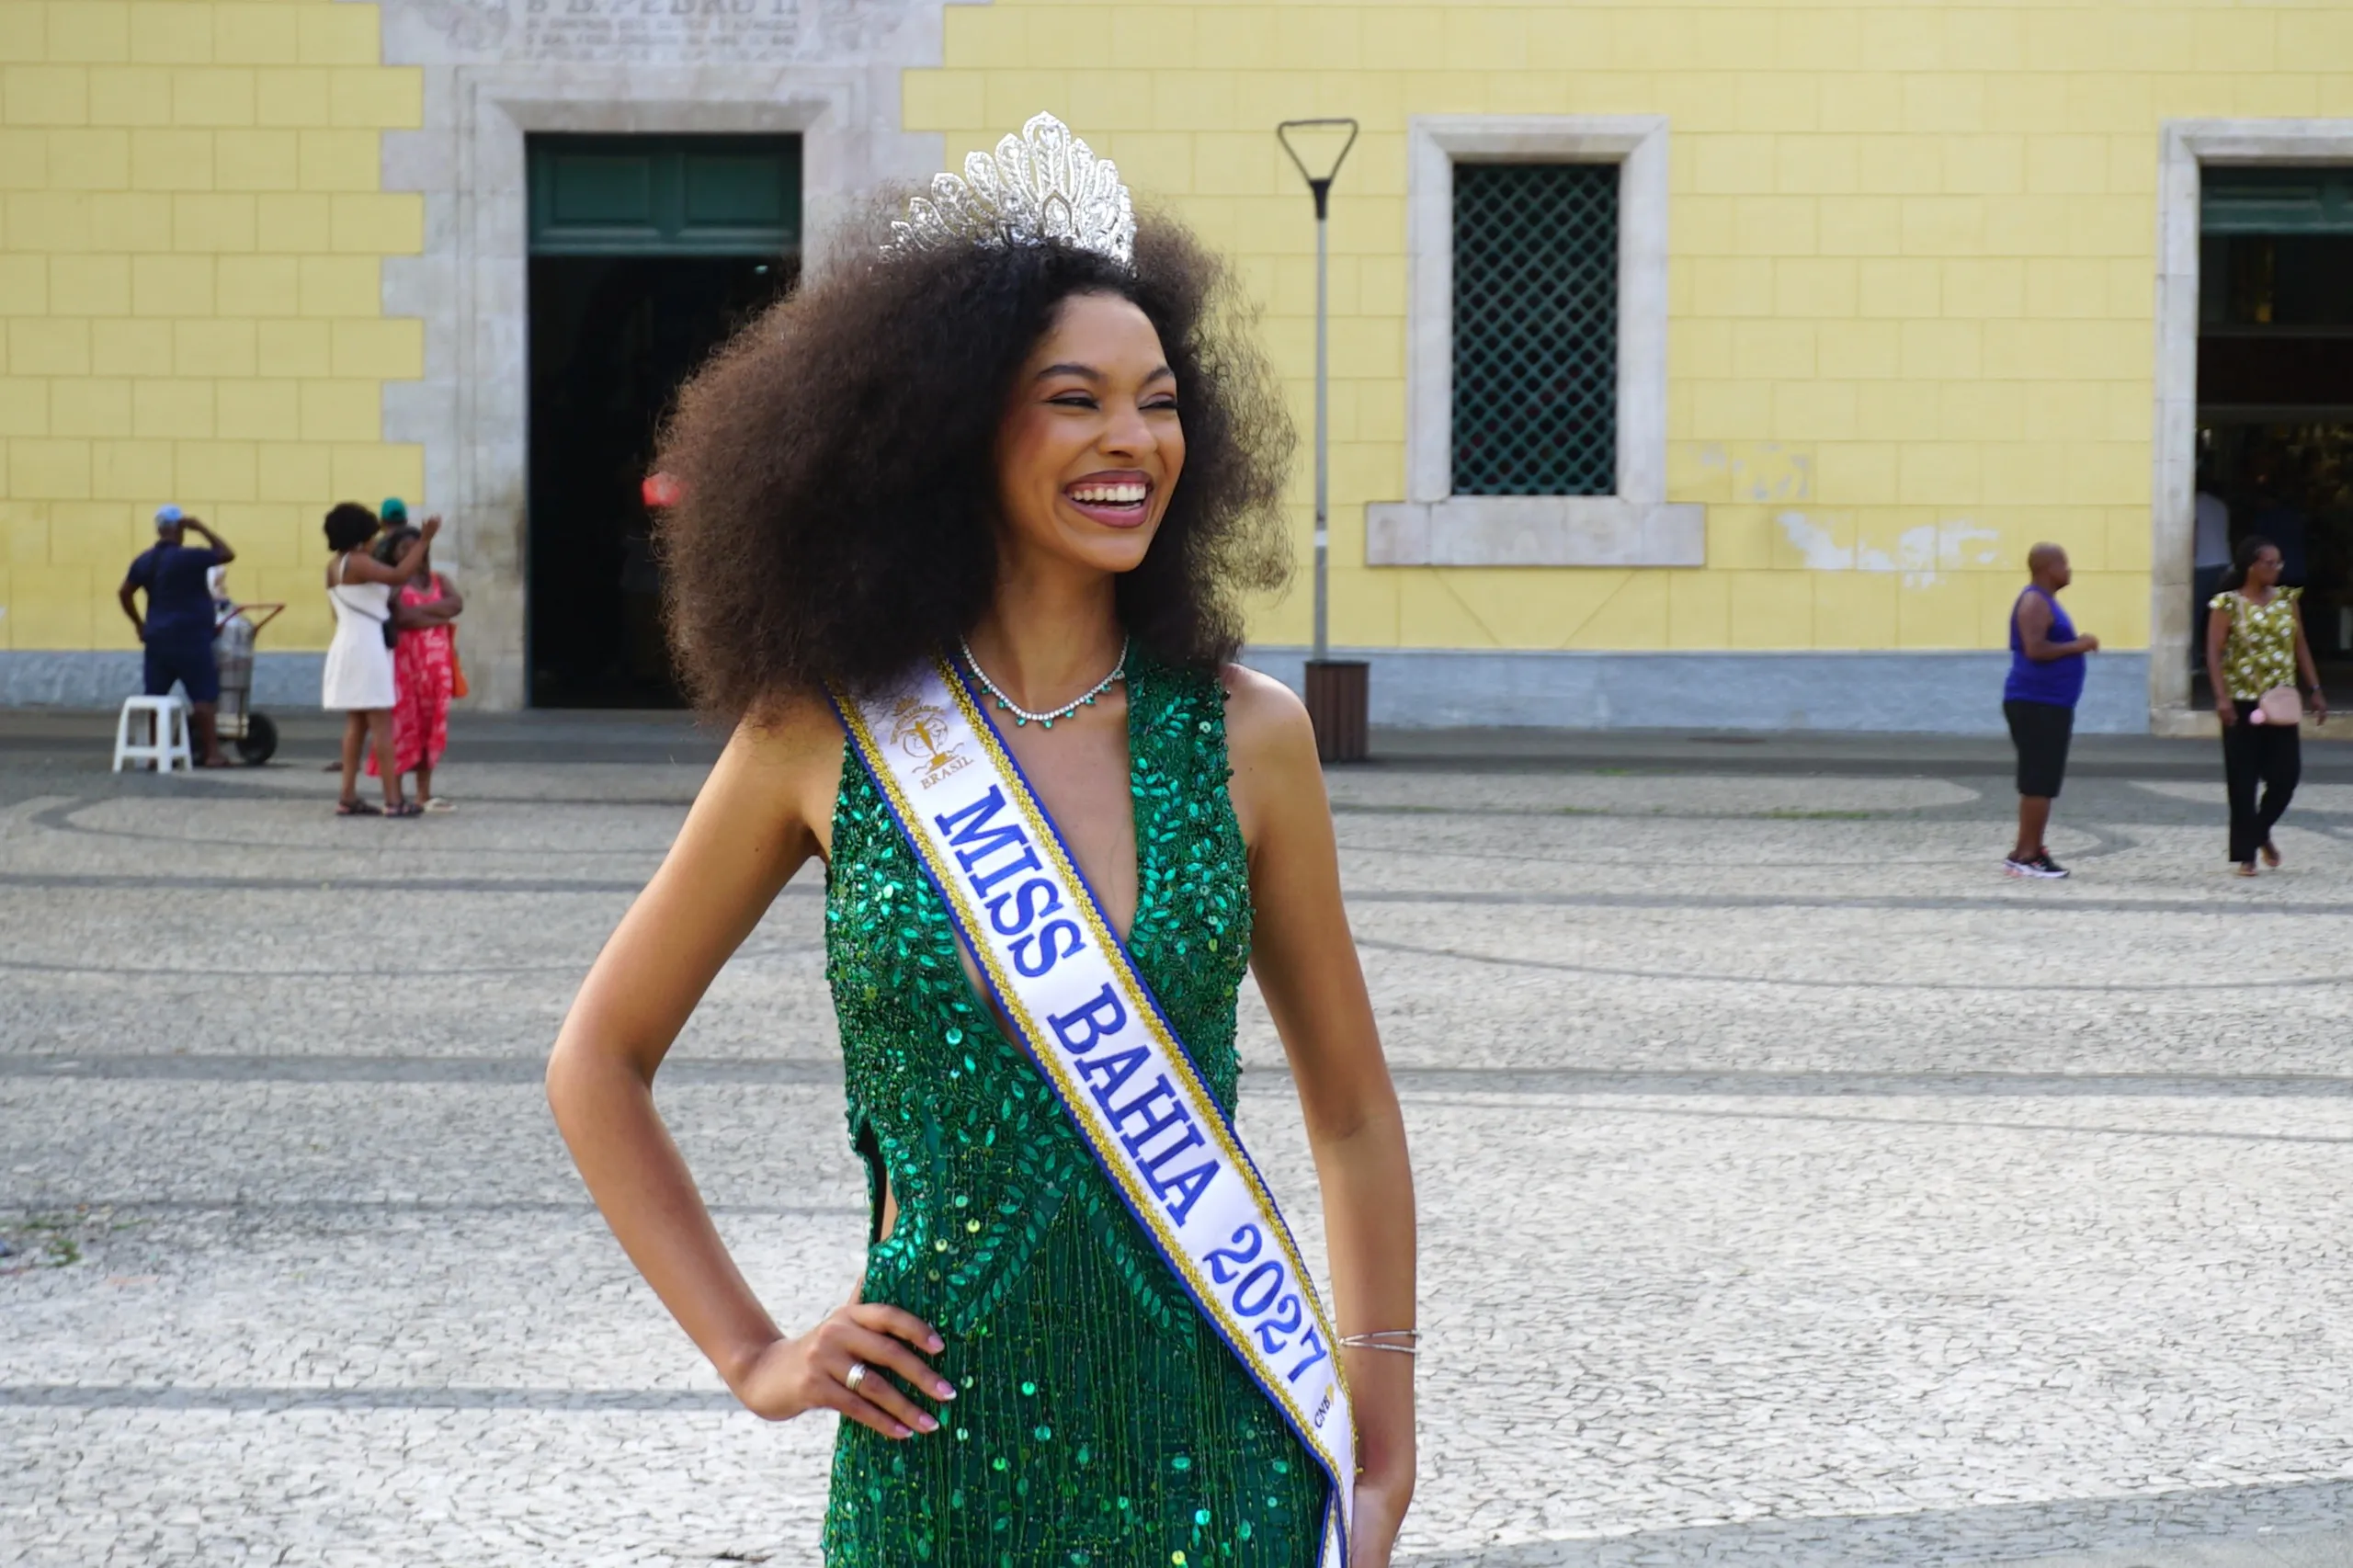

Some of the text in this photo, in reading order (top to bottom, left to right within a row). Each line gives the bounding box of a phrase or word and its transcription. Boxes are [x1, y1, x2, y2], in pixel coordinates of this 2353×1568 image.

[920, 756, 974, 790] BRASIL
[934, 784, 1328, 1384] MISS BAHIA 2027
[1313, 1393, 1332, 1428] CNB
